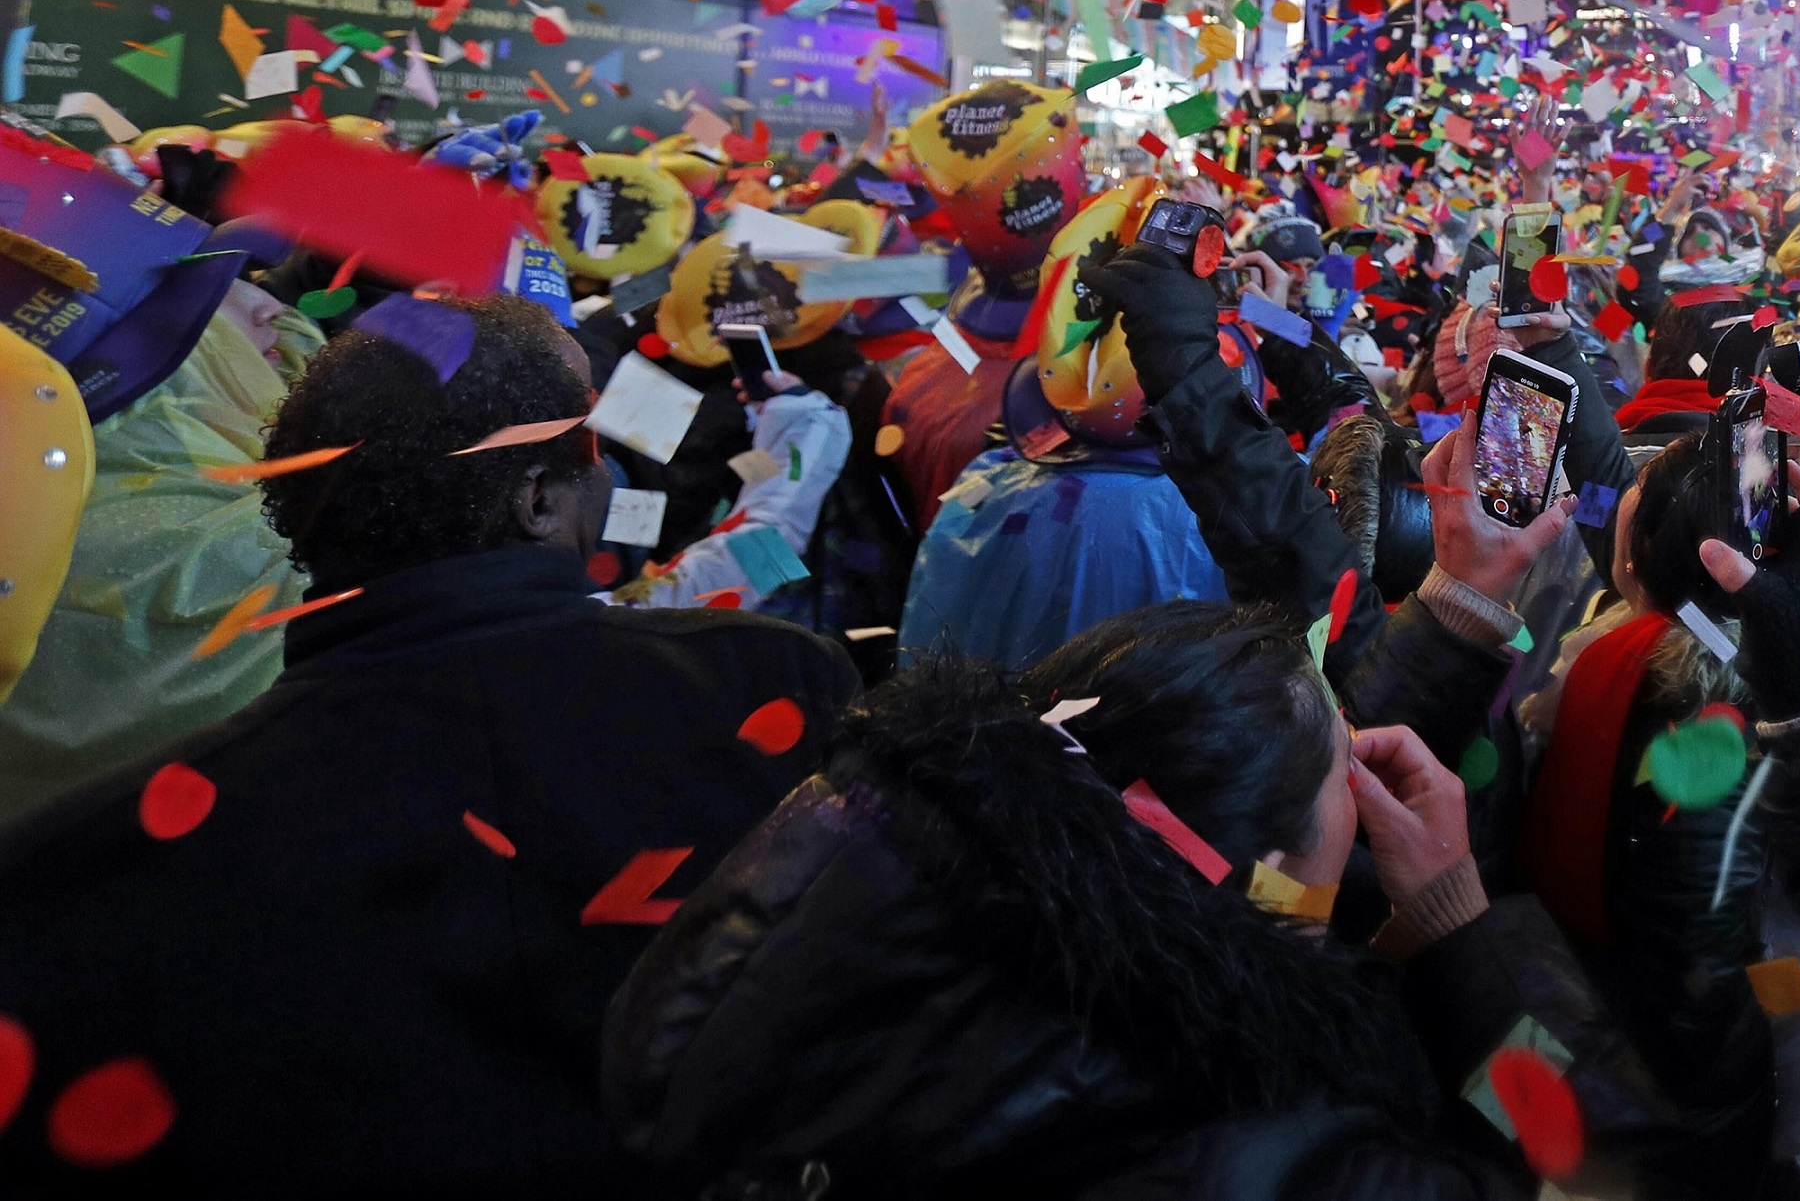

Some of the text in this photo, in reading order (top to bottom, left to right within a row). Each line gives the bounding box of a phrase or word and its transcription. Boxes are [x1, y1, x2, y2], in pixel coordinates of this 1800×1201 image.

[945, 104, 1006, 123] planet
[1004, 195, 1053, 225] planet
[14, 288, 64, 325] EVE
[41, 303, 86, 337] 2019
